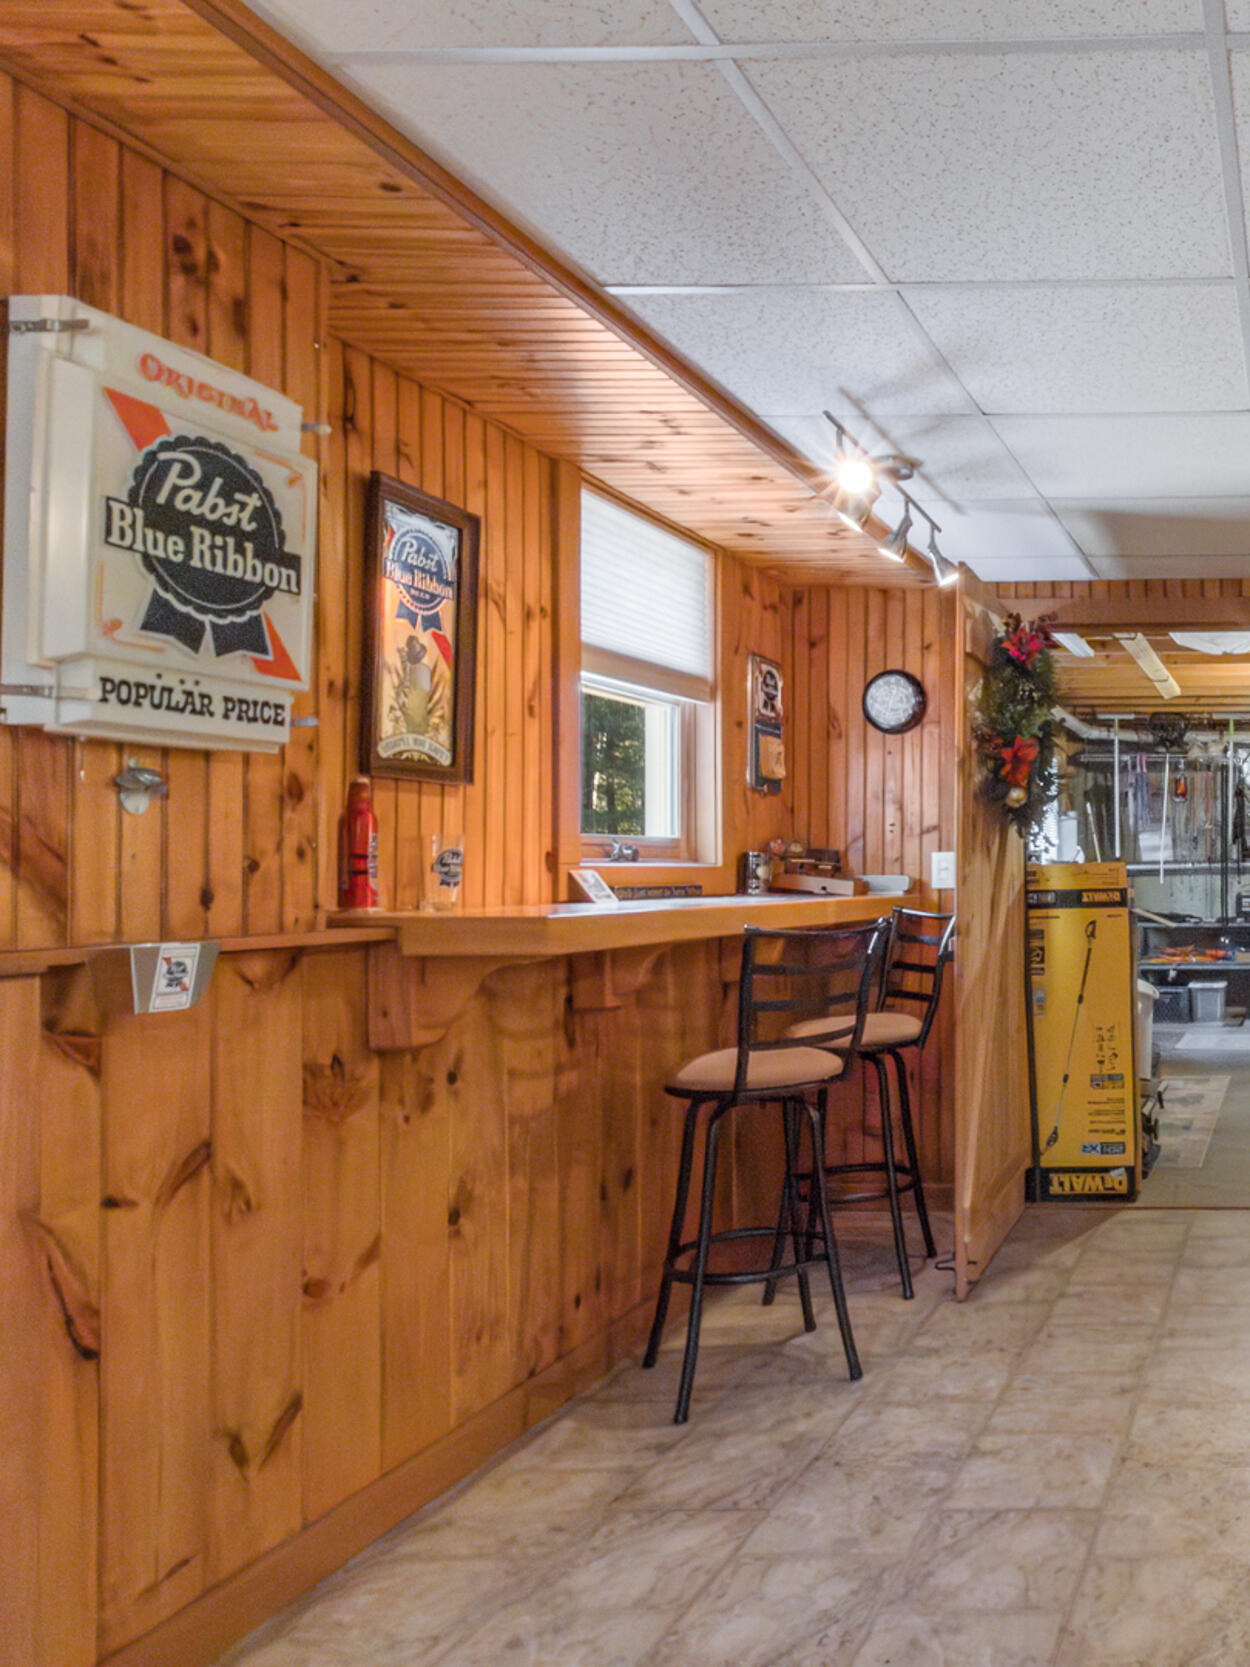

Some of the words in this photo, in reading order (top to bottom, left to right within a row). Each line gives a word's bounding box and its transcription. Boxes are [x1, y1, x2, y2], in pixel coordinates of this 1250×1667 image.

[140, 353, 279, 432] ORIGINAL
[156, 451, 262, 531] Pabst
[107, 499, 186, 563] Blue
[189, 525, 299, 593] Ribbon
[400, 537, 439, 572] Pabst
[98, 675, 215, 718] POPULAR
[222, 695, 286, 727] PRICE
